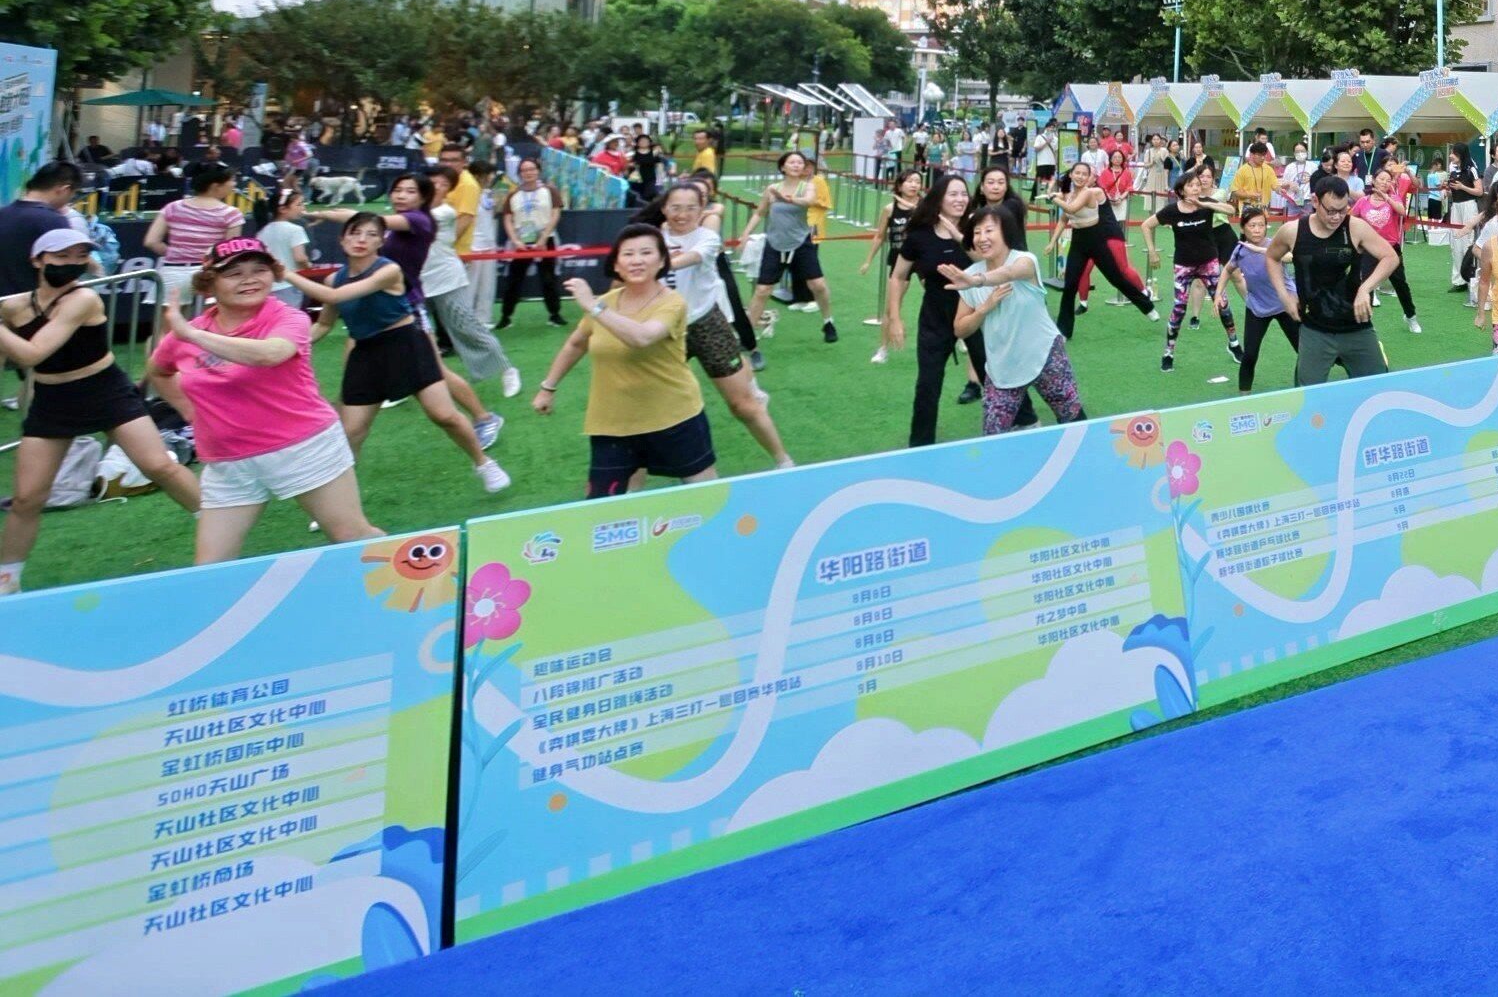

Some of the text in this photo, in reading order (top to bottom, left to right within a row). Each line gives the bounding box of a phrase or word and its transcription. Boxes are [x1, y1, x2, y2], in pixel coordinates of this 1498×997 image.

[215, 239, 262, 257] ROCK
[1231, 419, 1256, 432] SMG
[1365, 438, 1429, 465] 新华路街道
[594, 526, 639, 546] SMG
[820, 541, 928, 581] 华阳路街道
[533, 647, 613, 678] 趣味运动会
[1029, 537, 1110, 563] 华阳社区文化中心
[533, 666, 643, 703] 八段锦推广活动
[1032, 556, 1113, 584] 华阳社区文化中心
[532, 683, 674, 730] 全民健身日跳绳活动
[1034, 575, 1115, 604] 华阳社区文化中心
[856, 649, 903, 671] 8月10日
[167, 678, 290, 718] 虹桥体育公园
[532, 741, 644, 784] 健身气功站点赛
[1038, 615, 1120, 645] 华阳社区文化中心
[164, 699, 327, 747] 天山社区文化中心
[161, 732, 305, 777] 金虹桥国际中心
[157, 763, 290, 807] SOHO天山广场
[154, 785, 320, 839] 天山社区文化中心
[151, 814, 318, 871] 天山社区文化中心
[147, 860, 254, 903] 金虹桥商场
[143, 875, 314, 935] 天山社区文化中心
